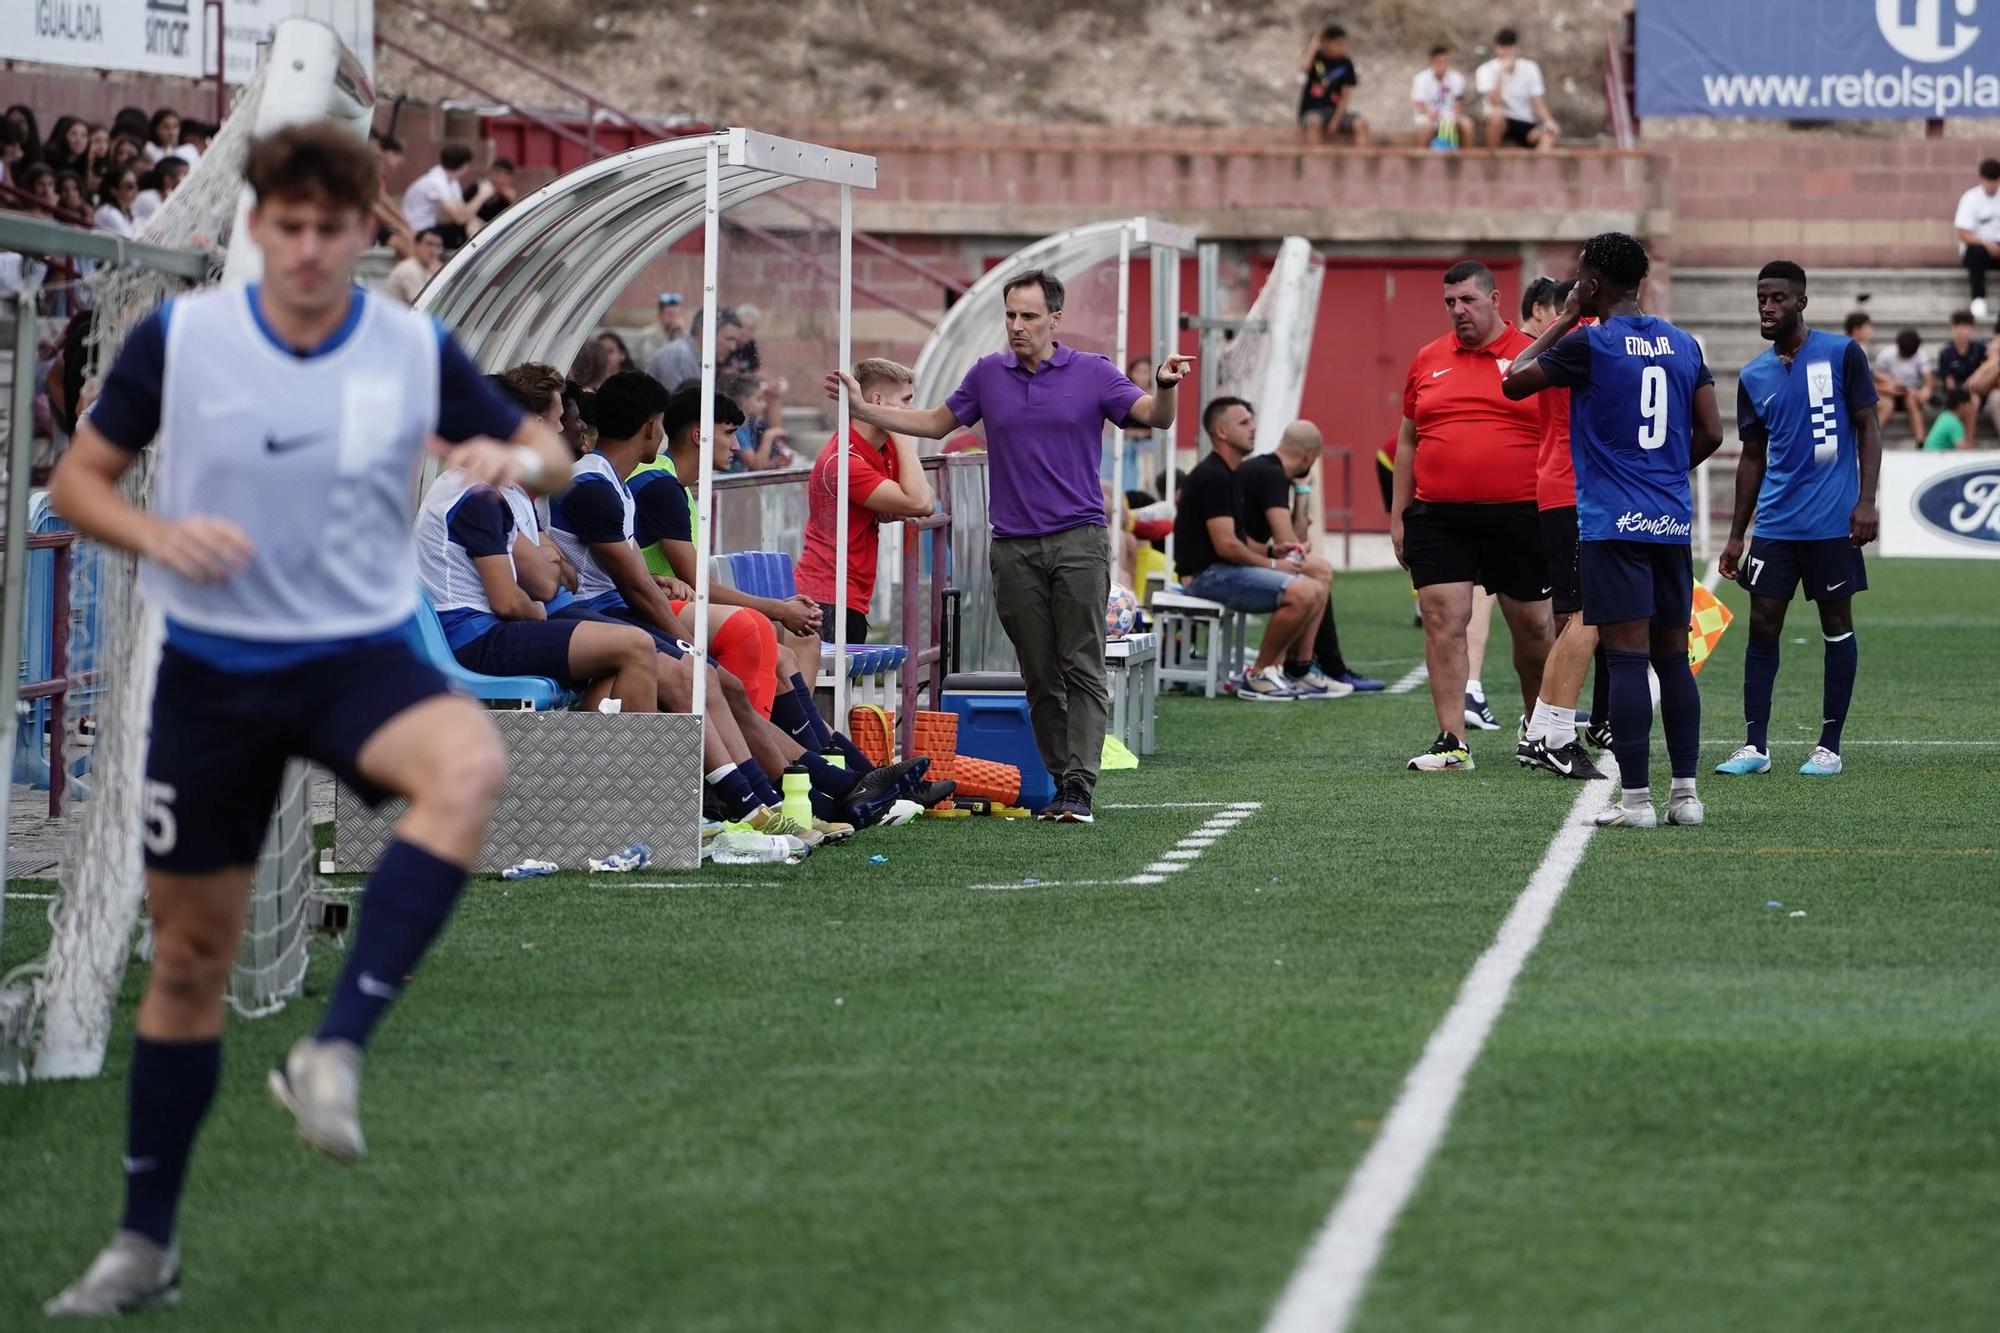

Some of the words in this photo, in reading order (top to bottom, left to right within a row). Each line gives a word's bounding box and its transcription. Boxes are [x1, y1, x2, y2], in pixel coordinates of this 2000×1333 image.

[34, 0, 103, 42] IGUALADA
[1701, 65, 2000, 117] www.retolspla
[1638, 365, 1668, 450] 9
